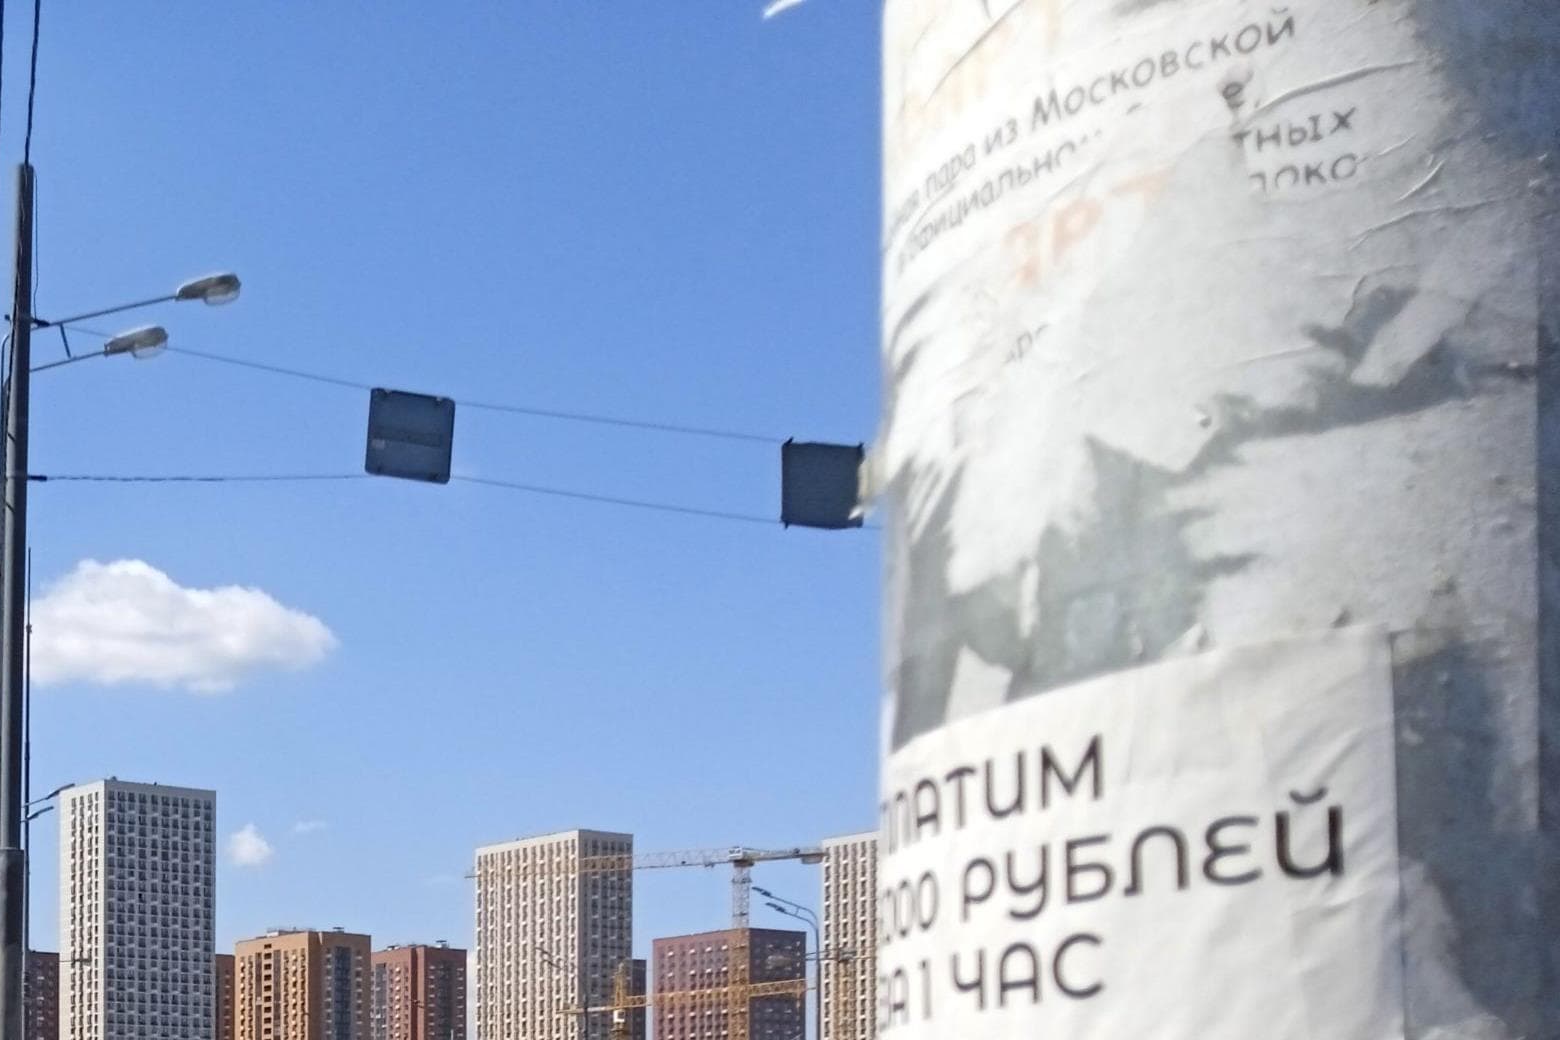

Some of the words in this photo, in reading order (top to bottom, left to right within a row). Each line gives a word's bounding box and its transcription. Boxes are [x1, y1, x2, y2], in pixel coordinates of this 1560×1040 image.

[1030, 8, 1295, 133] Московской
[962, 785, 1345, 924] РУБЛЕЙ
[951, 932, 1105, 1012] ЧАС
